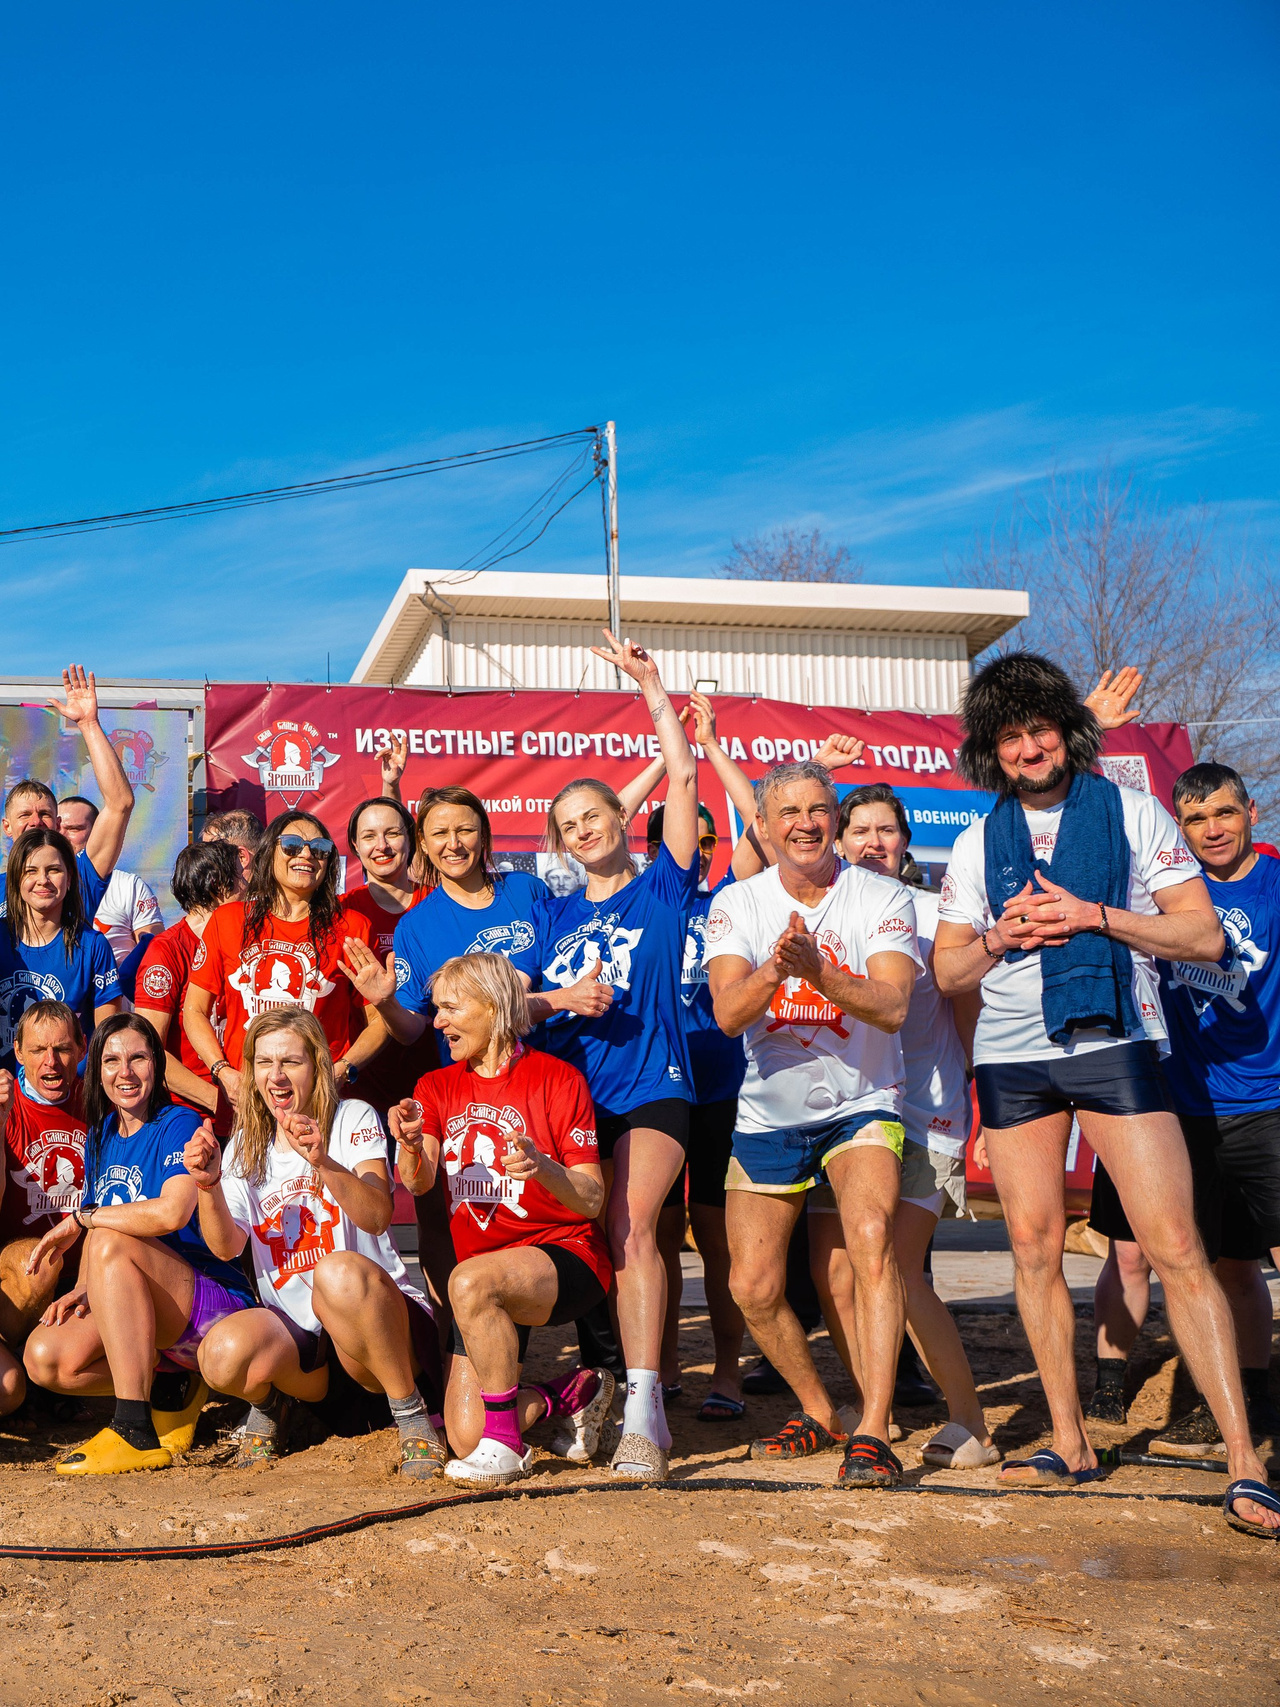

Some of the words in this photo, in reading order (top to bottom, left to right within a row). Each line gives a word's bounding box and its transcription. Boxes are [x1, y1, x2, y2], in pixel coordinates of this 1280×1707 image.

[867, 745, 954, 774] ТОГДА
[268, 771, 315, 787] ЯРОПОЛК
[1228, 909, 1248, 930] ДОЛГ
[878, 925, 913, 935] ДОМОЙ
[470, 1106, 497, 1121] СЛАВА
[503, 1107, 523, 1129] ДОЛГ
[927, 1123, 952, 1133] SPORT
[455, 1176, 514, 1198] ЯРОПОЛК
[36, 1193, 84, 1209] ЯРОПОЛ
